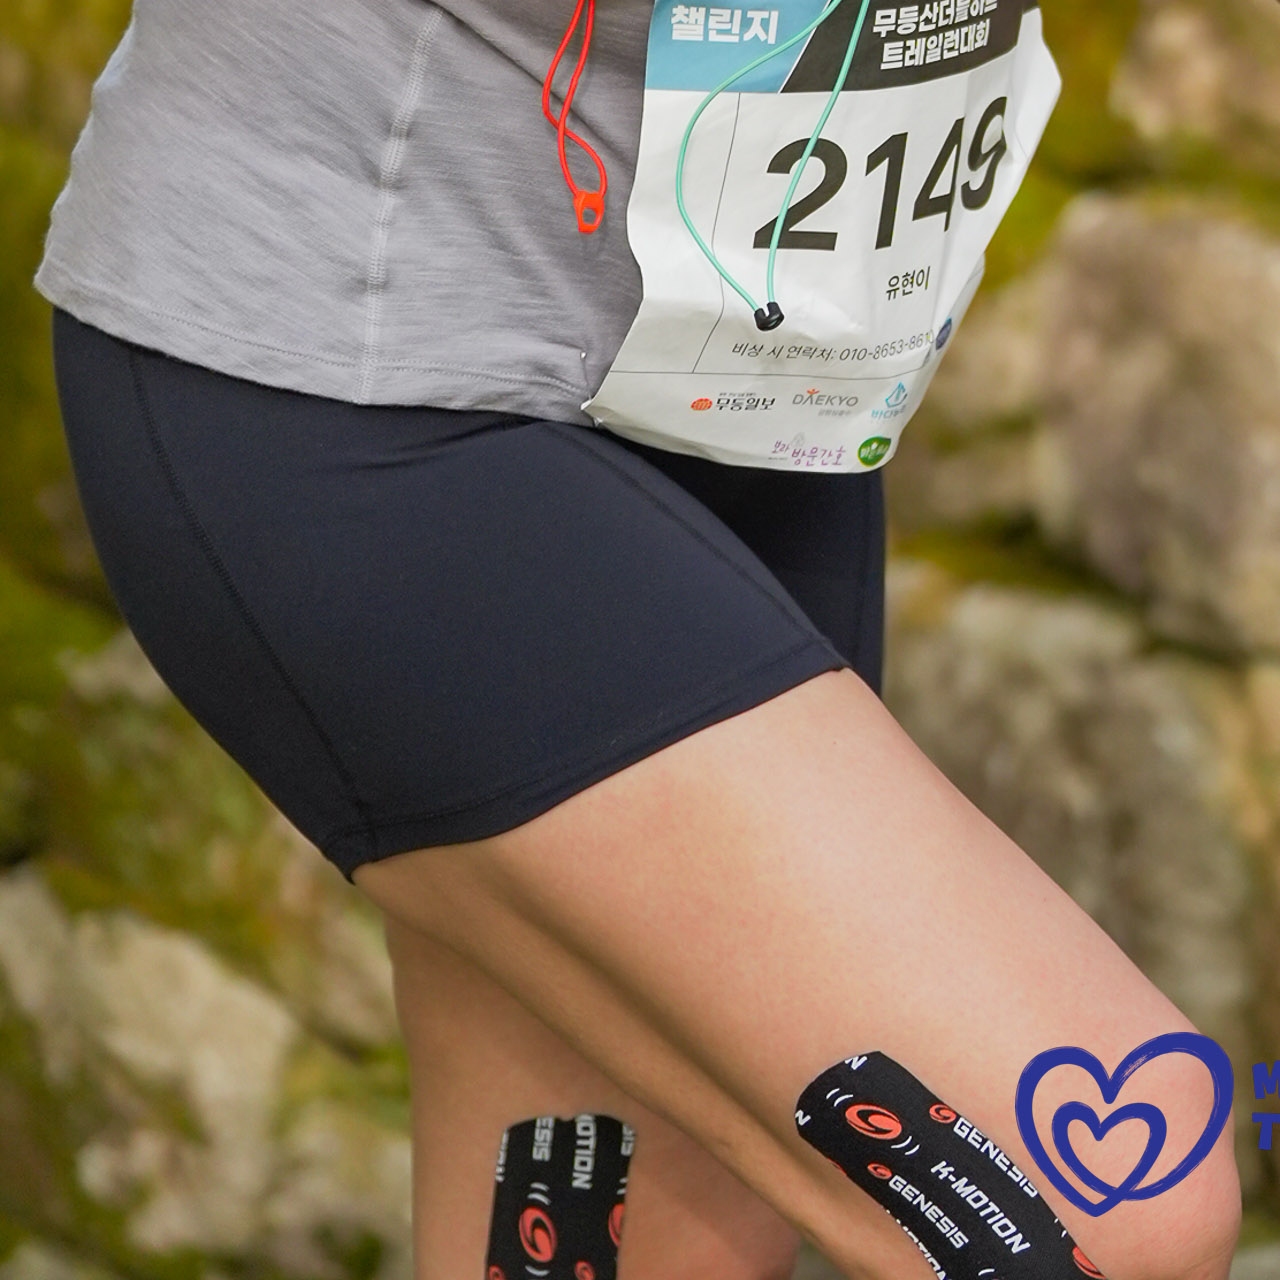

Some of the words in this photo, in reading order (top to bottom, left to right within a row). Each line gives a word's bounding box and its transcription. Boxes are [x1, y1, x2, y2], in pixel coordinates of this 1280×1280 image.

[671, 4, 779, 45] 챌린지
[880, 20, 991, 70] 트레일런대회
[753, 96, 1007, 251] 2149
[886, 265, 930, 301] 유현이
[732, 342, 764, 358] 비상
[767, 343, 785, 360] 시
[786, 344, 837, 362] 연락처:
[716, 397, 776, 412] 무등일보
[792, 391, 859, 407] DAEKYO
[888, 1175, 969, 1249] GENESIS
[930, 1160, 1031, 1254] K-MOTION
